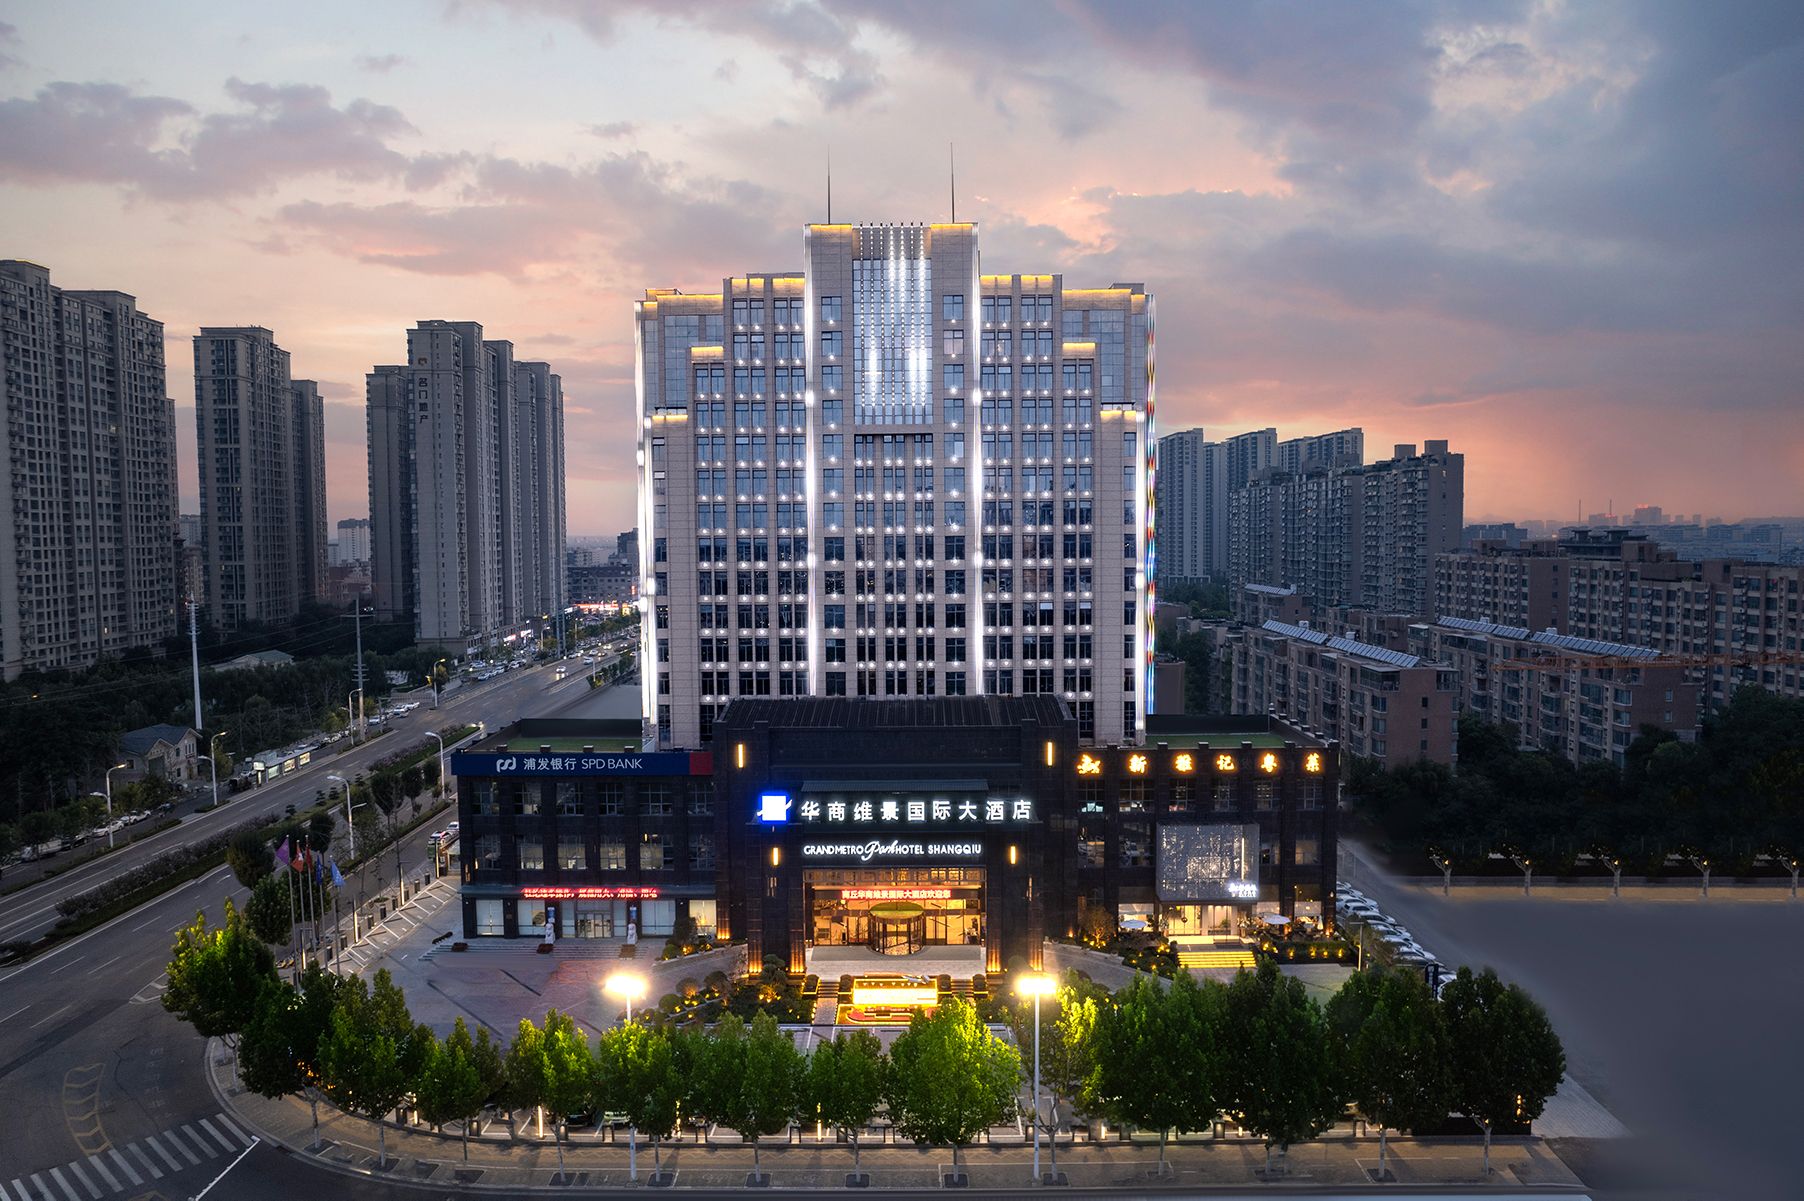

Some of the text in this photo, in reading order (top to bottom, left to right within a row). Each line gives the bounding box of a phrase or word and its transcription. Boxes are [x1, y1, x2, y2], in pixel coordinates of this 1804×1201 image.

[418, 377, 429, 424] 名门地产
[523, 757, 577, 770] 浦发银行
[581, 758, 643, 769] SPD BANK
[801, 800, 1031, 821] 华商维景国际大酒店
[896, 844, 925, 854] HOTEL
[927, 844, 982, 854] SHANGQIU
